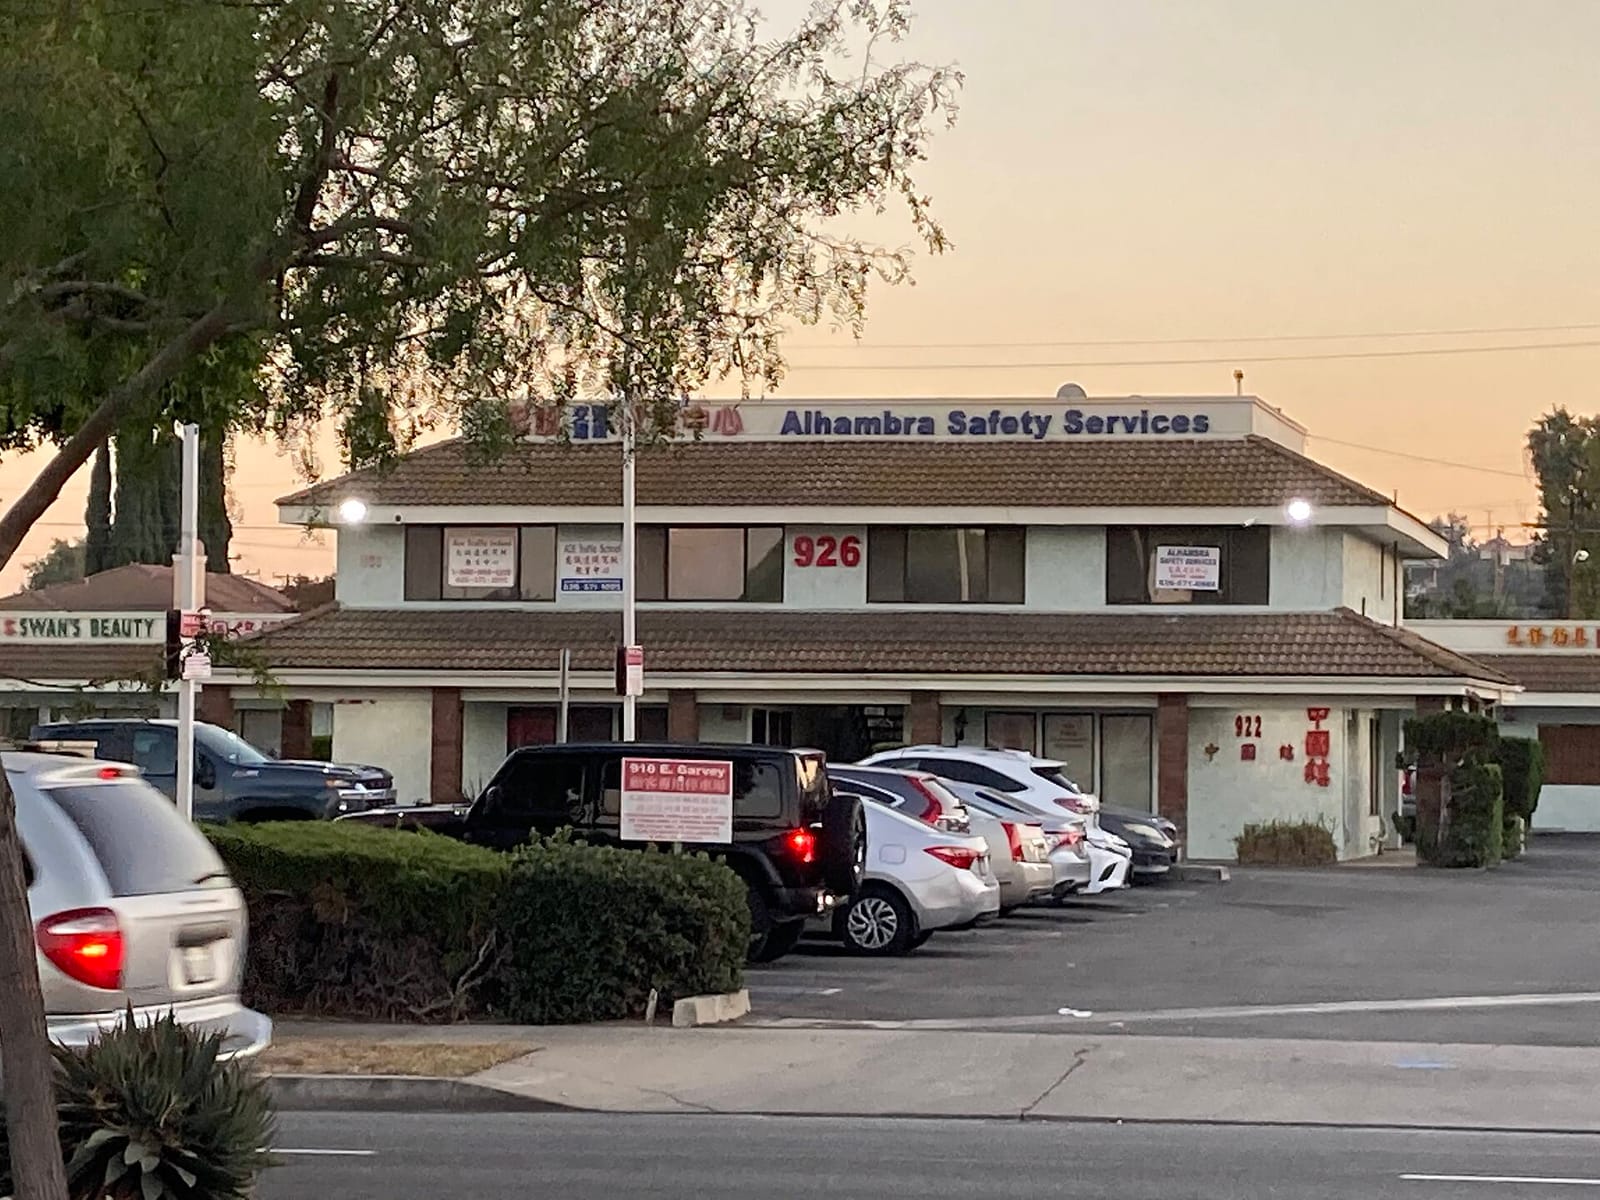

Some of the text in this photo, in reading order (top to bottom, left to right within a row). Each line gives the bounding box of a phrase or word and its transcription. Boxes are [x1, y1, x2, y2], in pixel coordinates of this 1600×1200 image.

[781, 410, 1209, 439] Alhambra Safety Services
[794, 536, 861, 568] 926
[19, 617, 81, 638] SWAN'S
[90, 617, 154, 638] BEAUTY
[1235, 714, 1262, 738] 922
